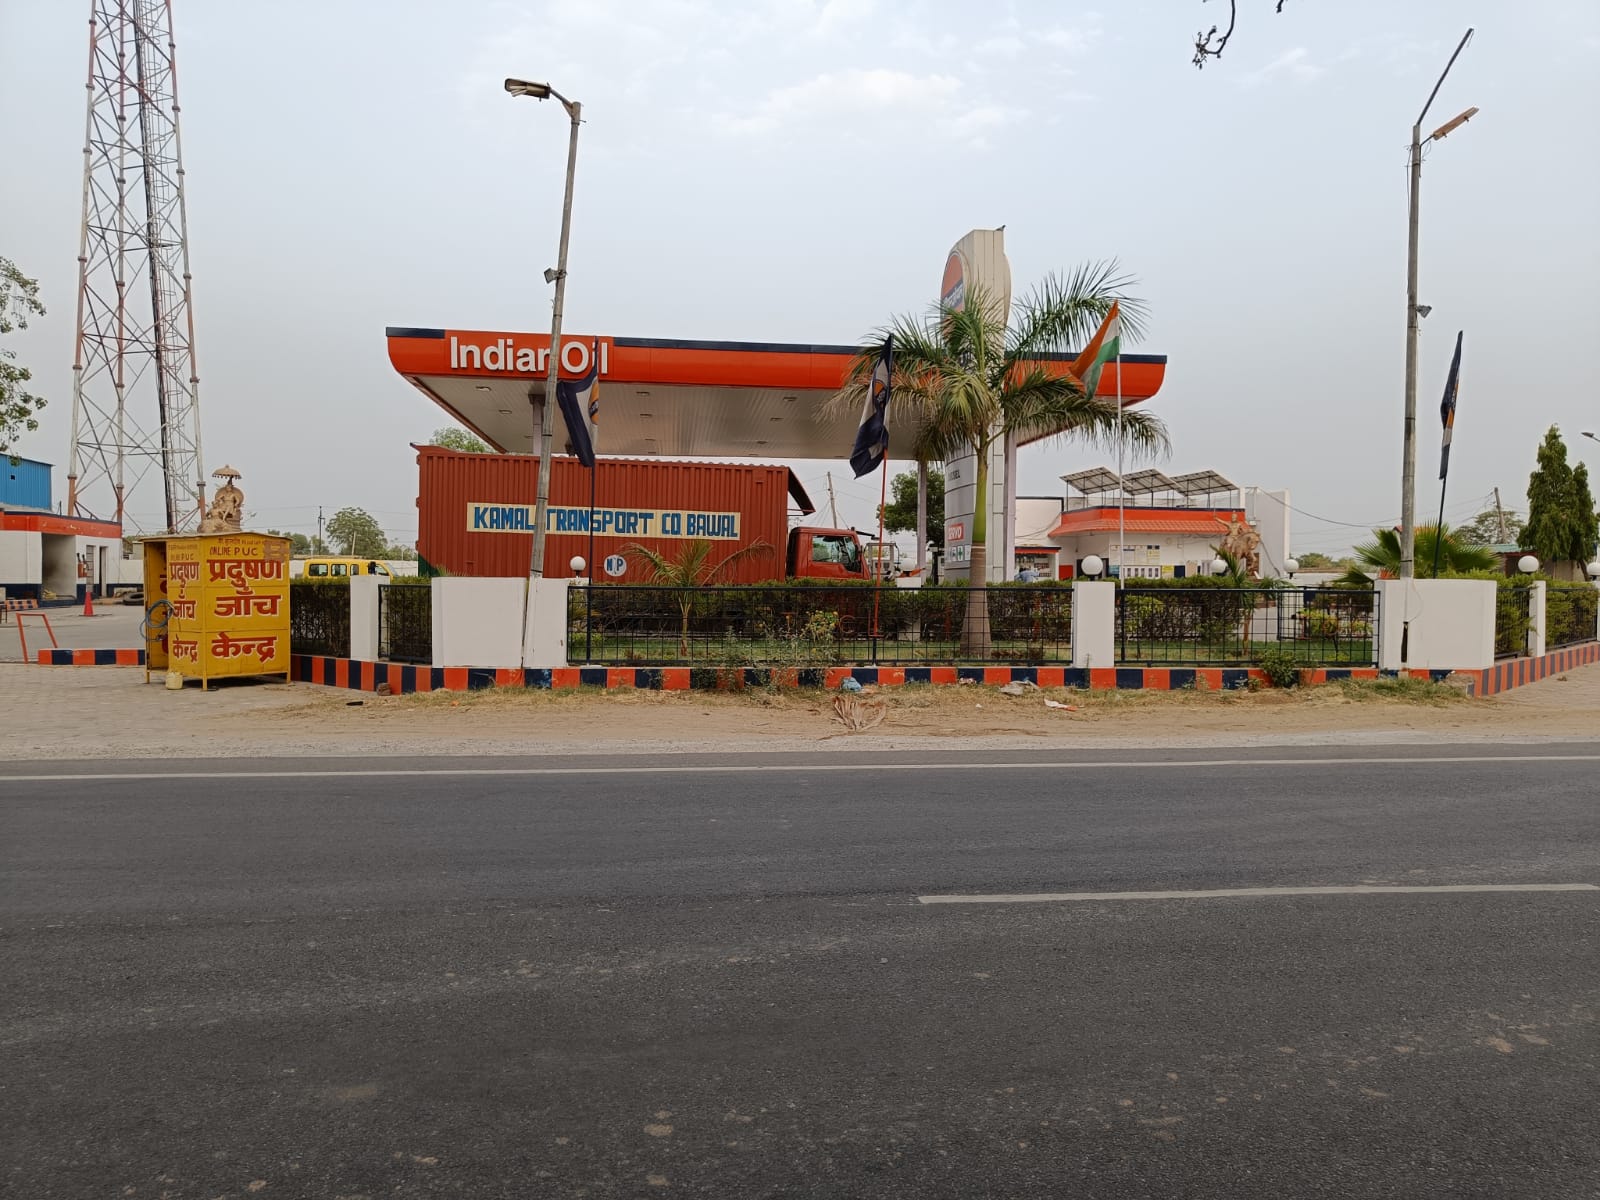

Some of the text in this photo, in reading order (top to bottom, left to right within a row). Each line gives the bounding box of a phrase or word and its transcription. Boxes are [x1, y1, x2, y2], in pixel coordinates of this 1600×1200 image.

[474, 506, 537, 530] KAMAL
[546, 508, 654, 534] TRANSPORT
[686, 513, 738, 537] BAWAL
[211, 631, 278, 663] केन्द्र
